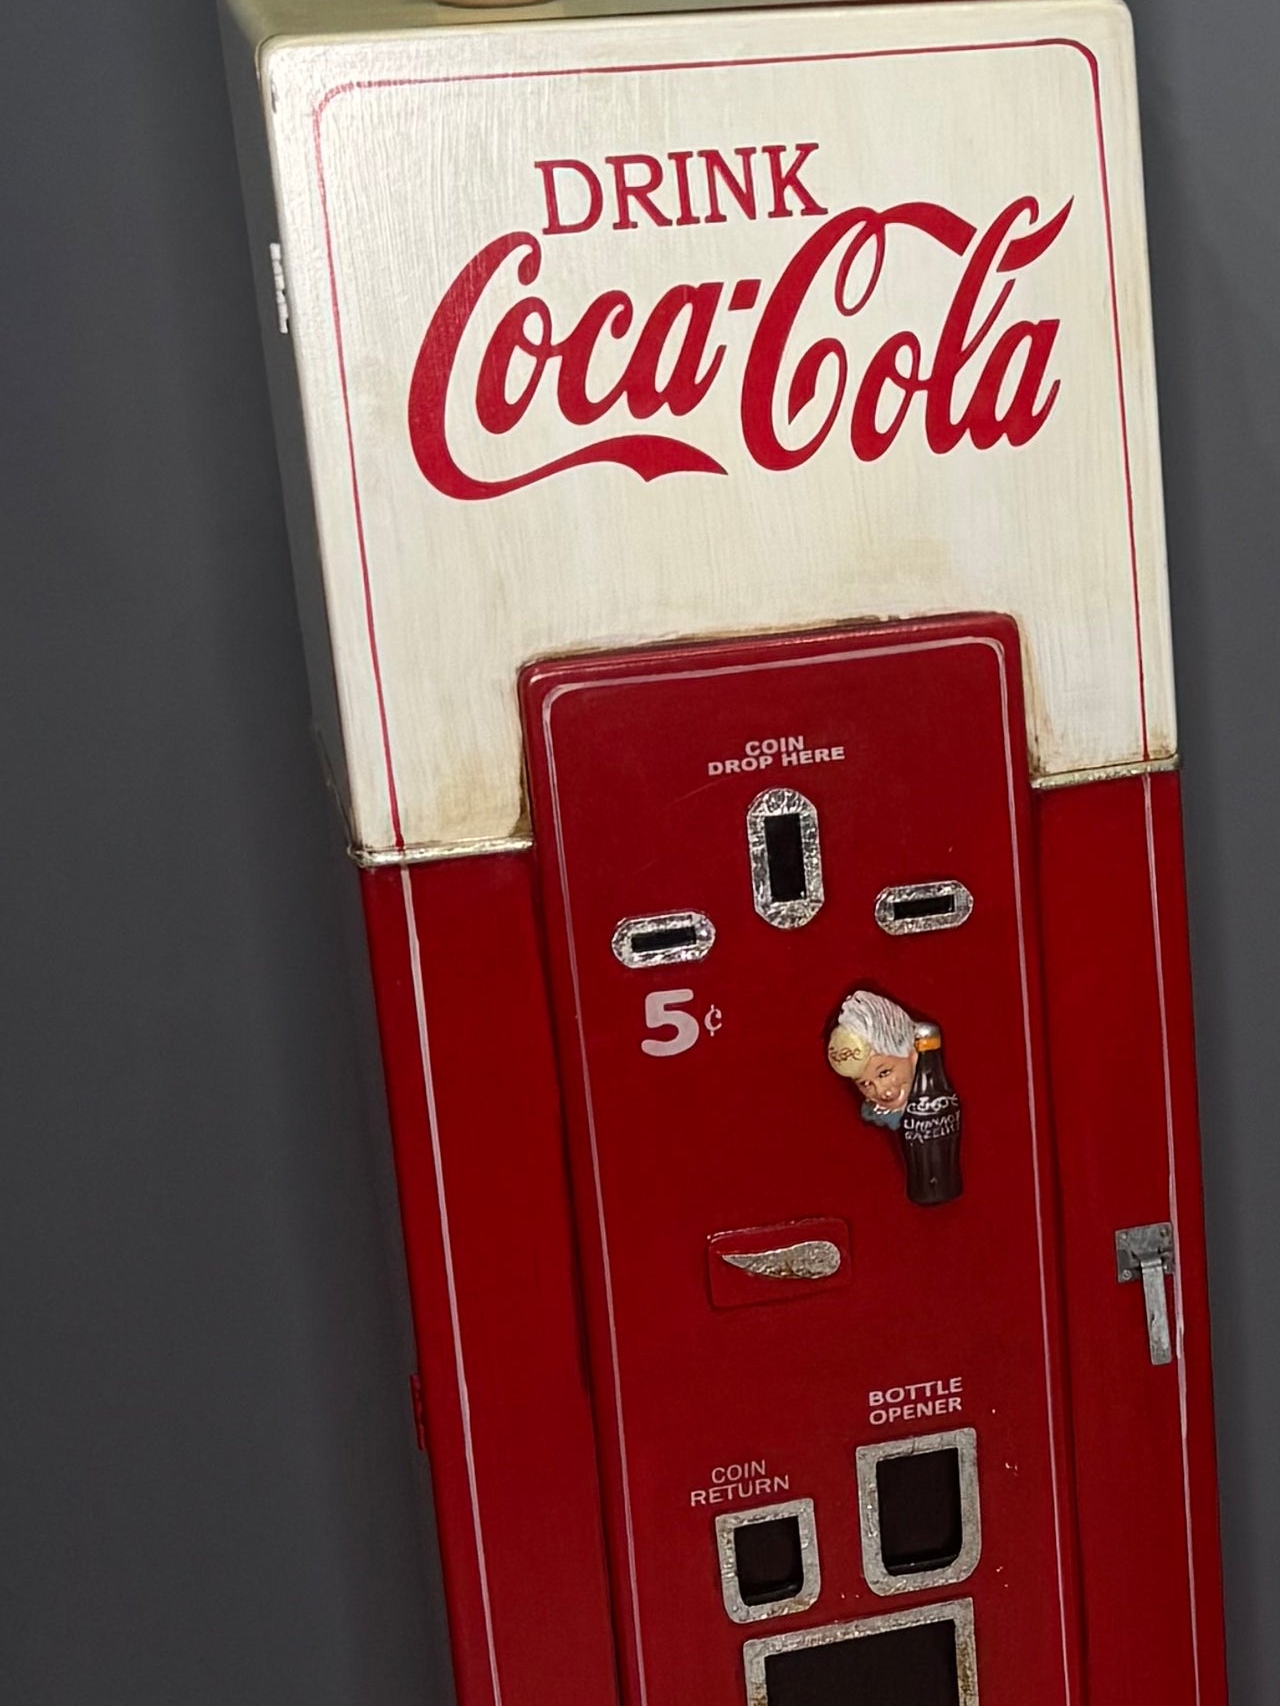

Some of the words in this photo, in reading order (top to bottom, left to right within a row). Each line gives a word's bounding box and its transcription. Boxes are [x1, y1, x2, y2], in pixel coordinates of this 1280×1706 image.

[533, 142, 829, 236] DRINK
[407, 194, 1075, 501] Coca-Cola
[707, 755, 774, 777] DROP
[781, 746, 846, 768] HERE
[744, 735, 805, 757] COIN
[640, 988, 723, 1057] 5¢
[868, 1376, 963, 1407] BOTTLE
[869, 1396, 962, 1426] OPENER
[711, 1459, 766, 1485] COIN
[690, 1474, 790, 1507] RETURN
